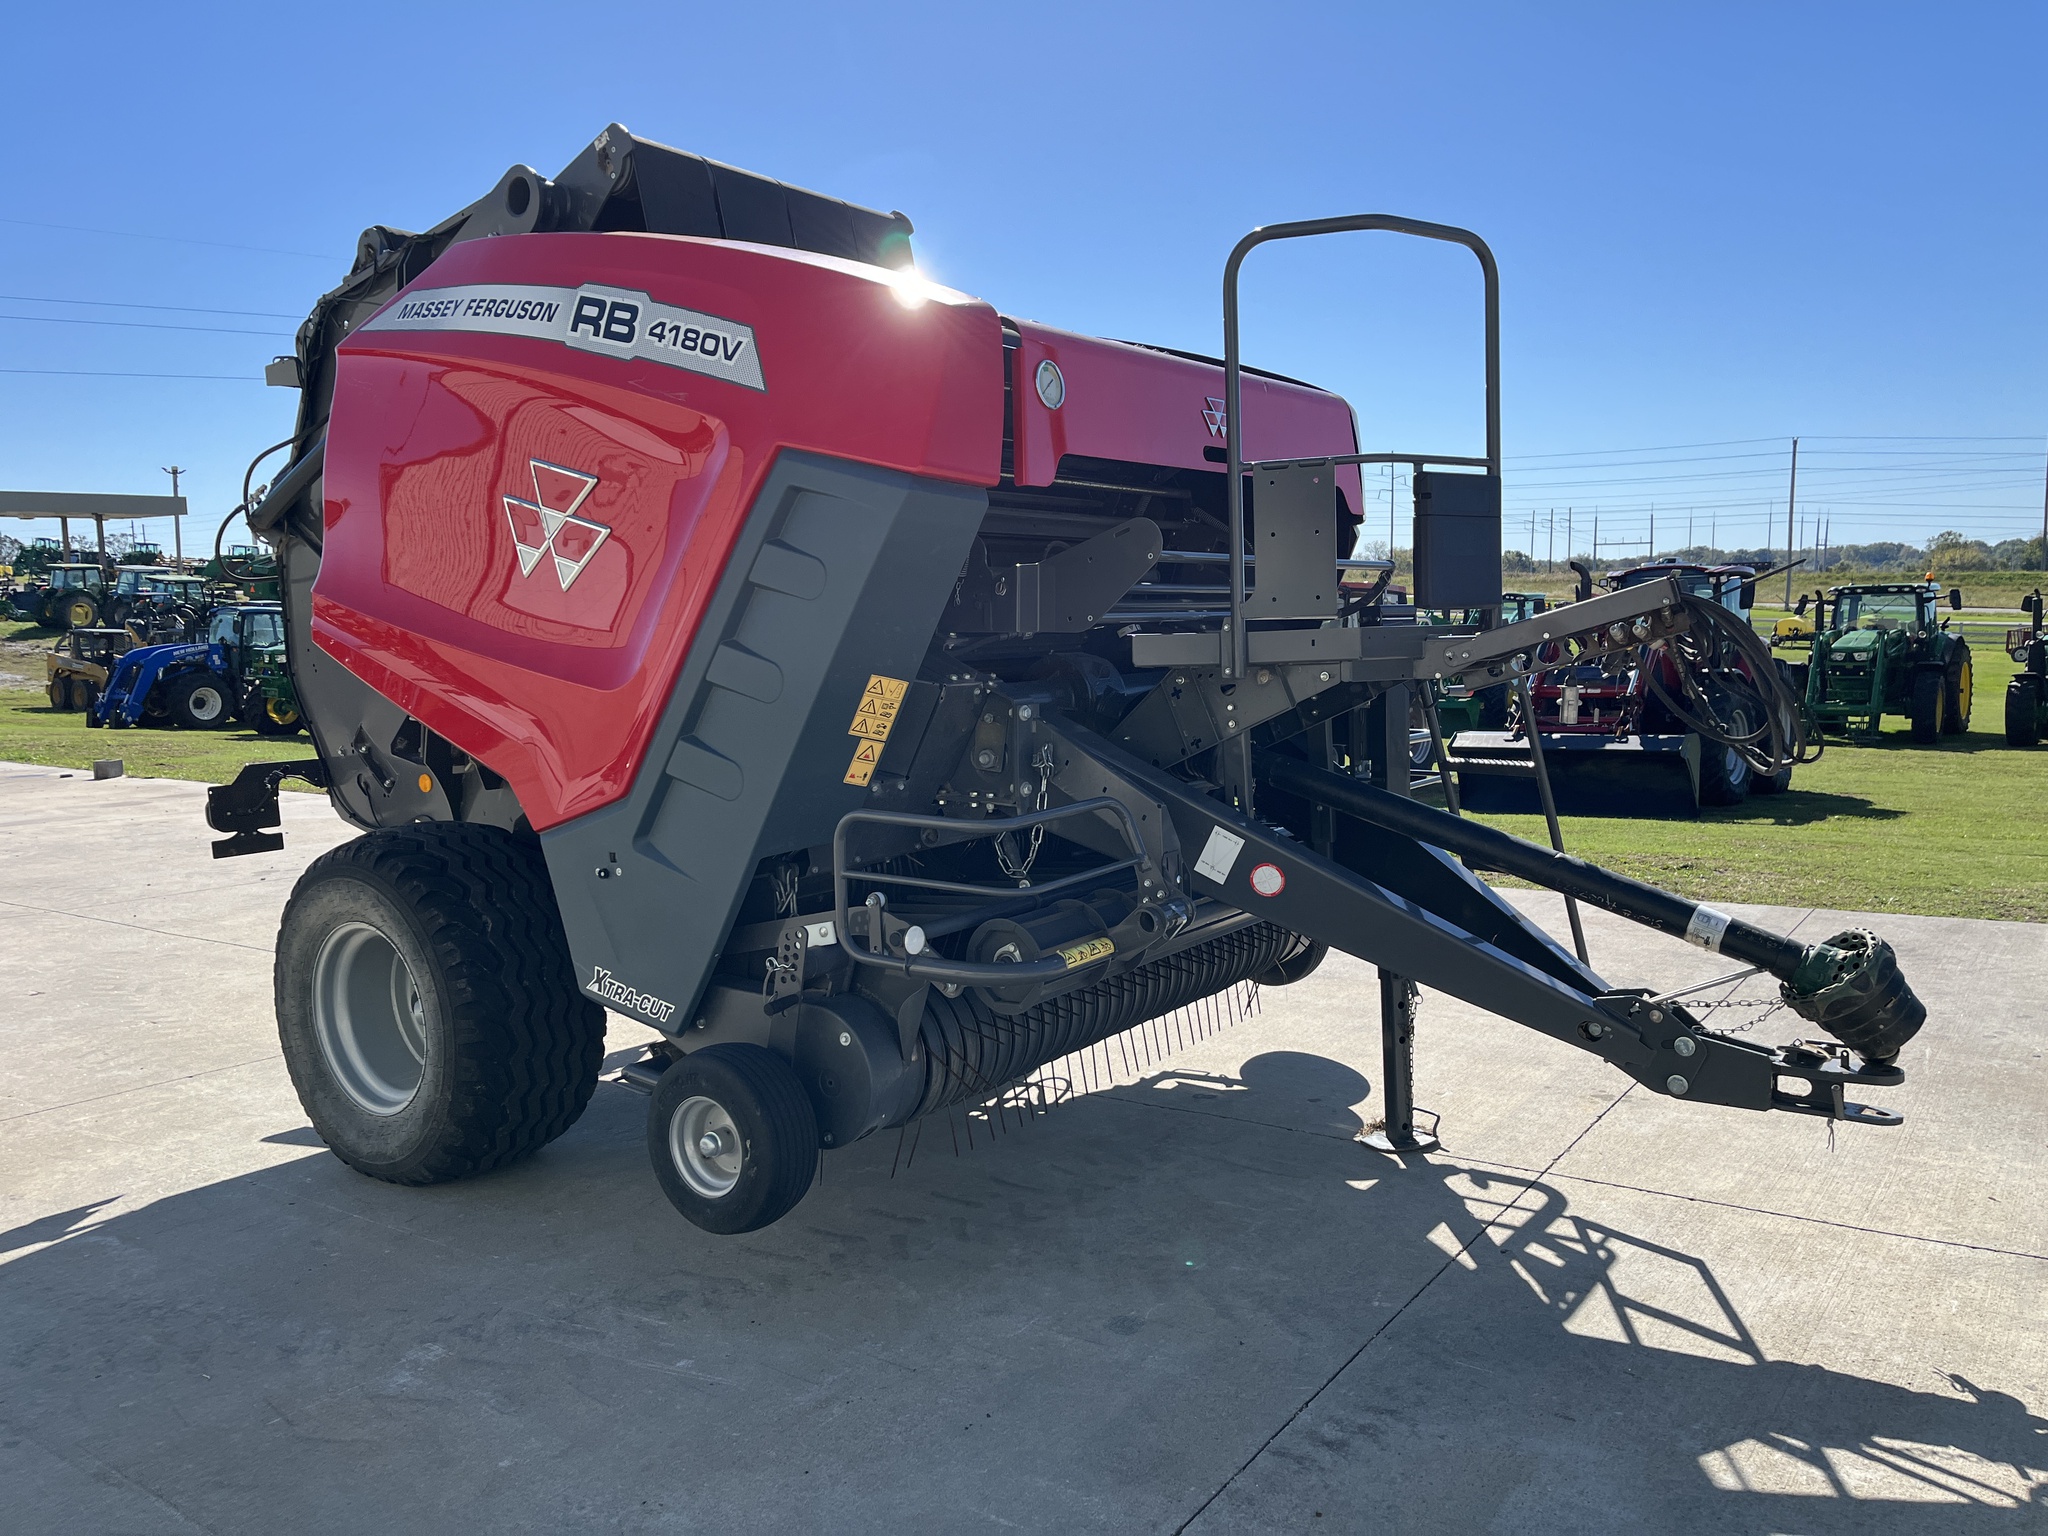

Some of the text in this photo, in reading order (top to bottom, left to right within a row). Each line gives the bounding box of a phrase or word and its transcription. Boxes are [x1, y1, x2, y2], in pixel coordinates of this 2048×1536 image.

[397, 298, 560, 323] MASSEY FERGUSON
[570, 295, 743, 361] RB 4180V
